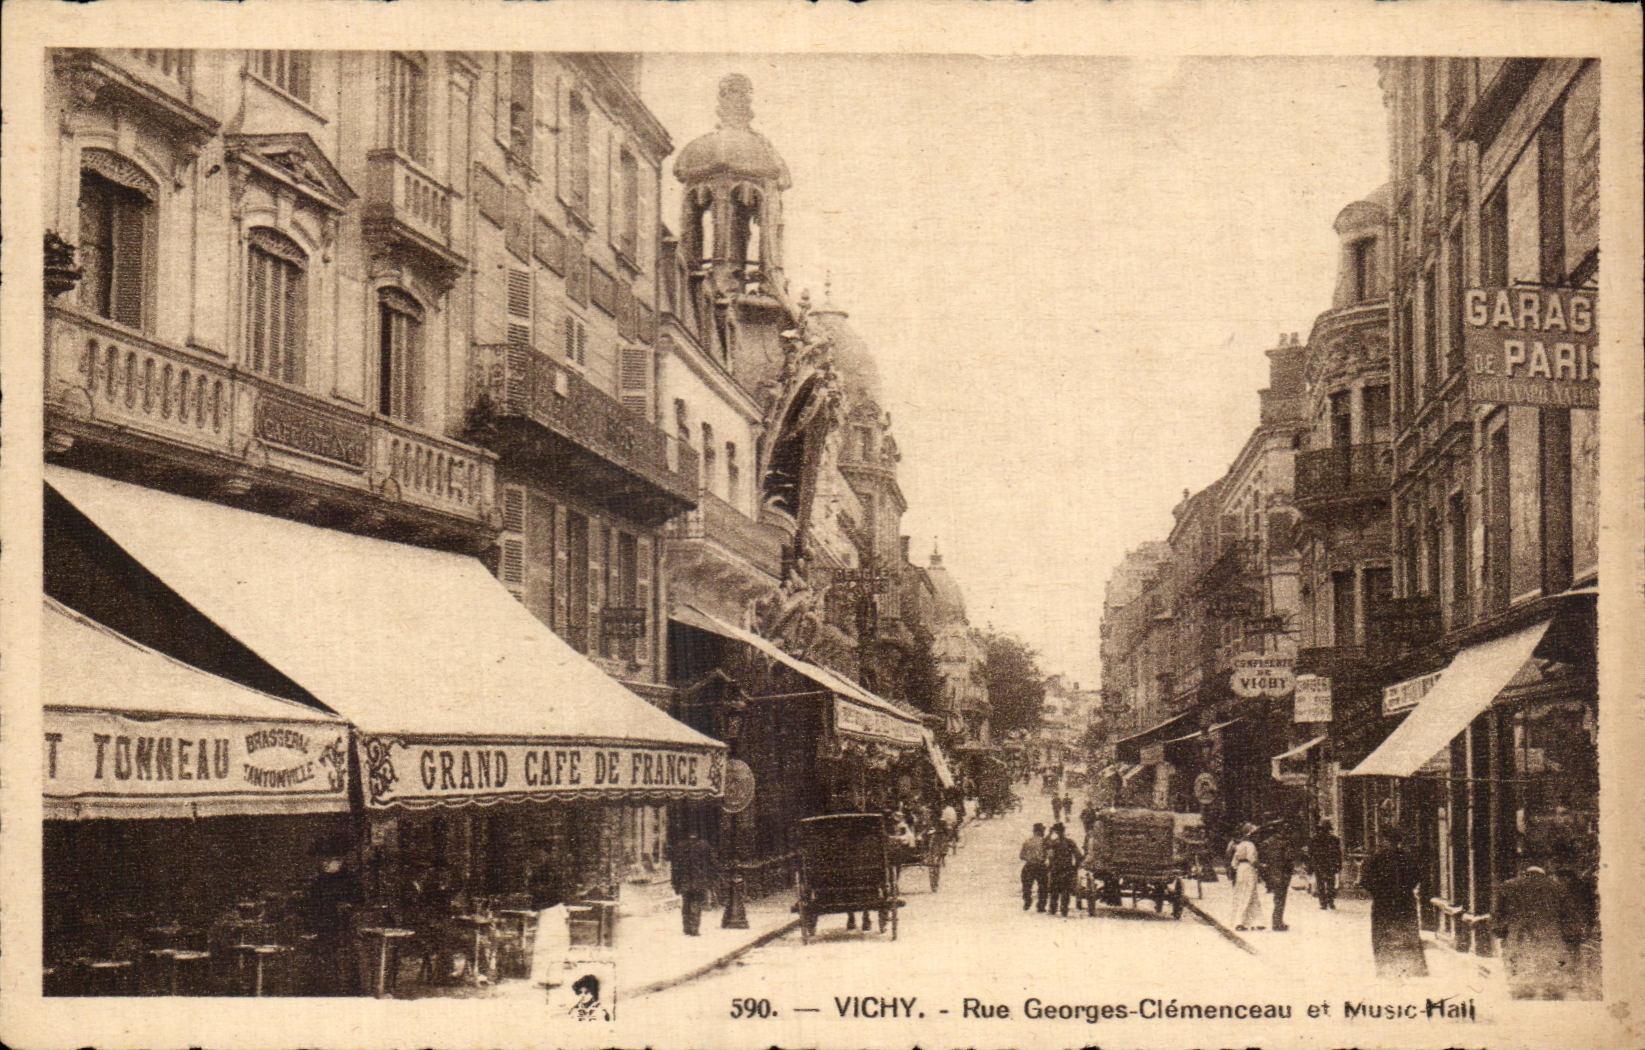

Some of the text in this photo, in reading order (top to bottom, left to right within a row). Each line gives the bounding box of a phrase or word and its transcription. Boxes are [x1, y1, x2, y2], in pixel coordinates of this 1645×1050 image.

[1465, 289, 1599, 333] GARAG
[1240, 677, 1287, 689] VICHY
[93, 732, 229, 782] TONNEAU
[420, 749, 698, 790] GRAND CAFE DE FRANCE
